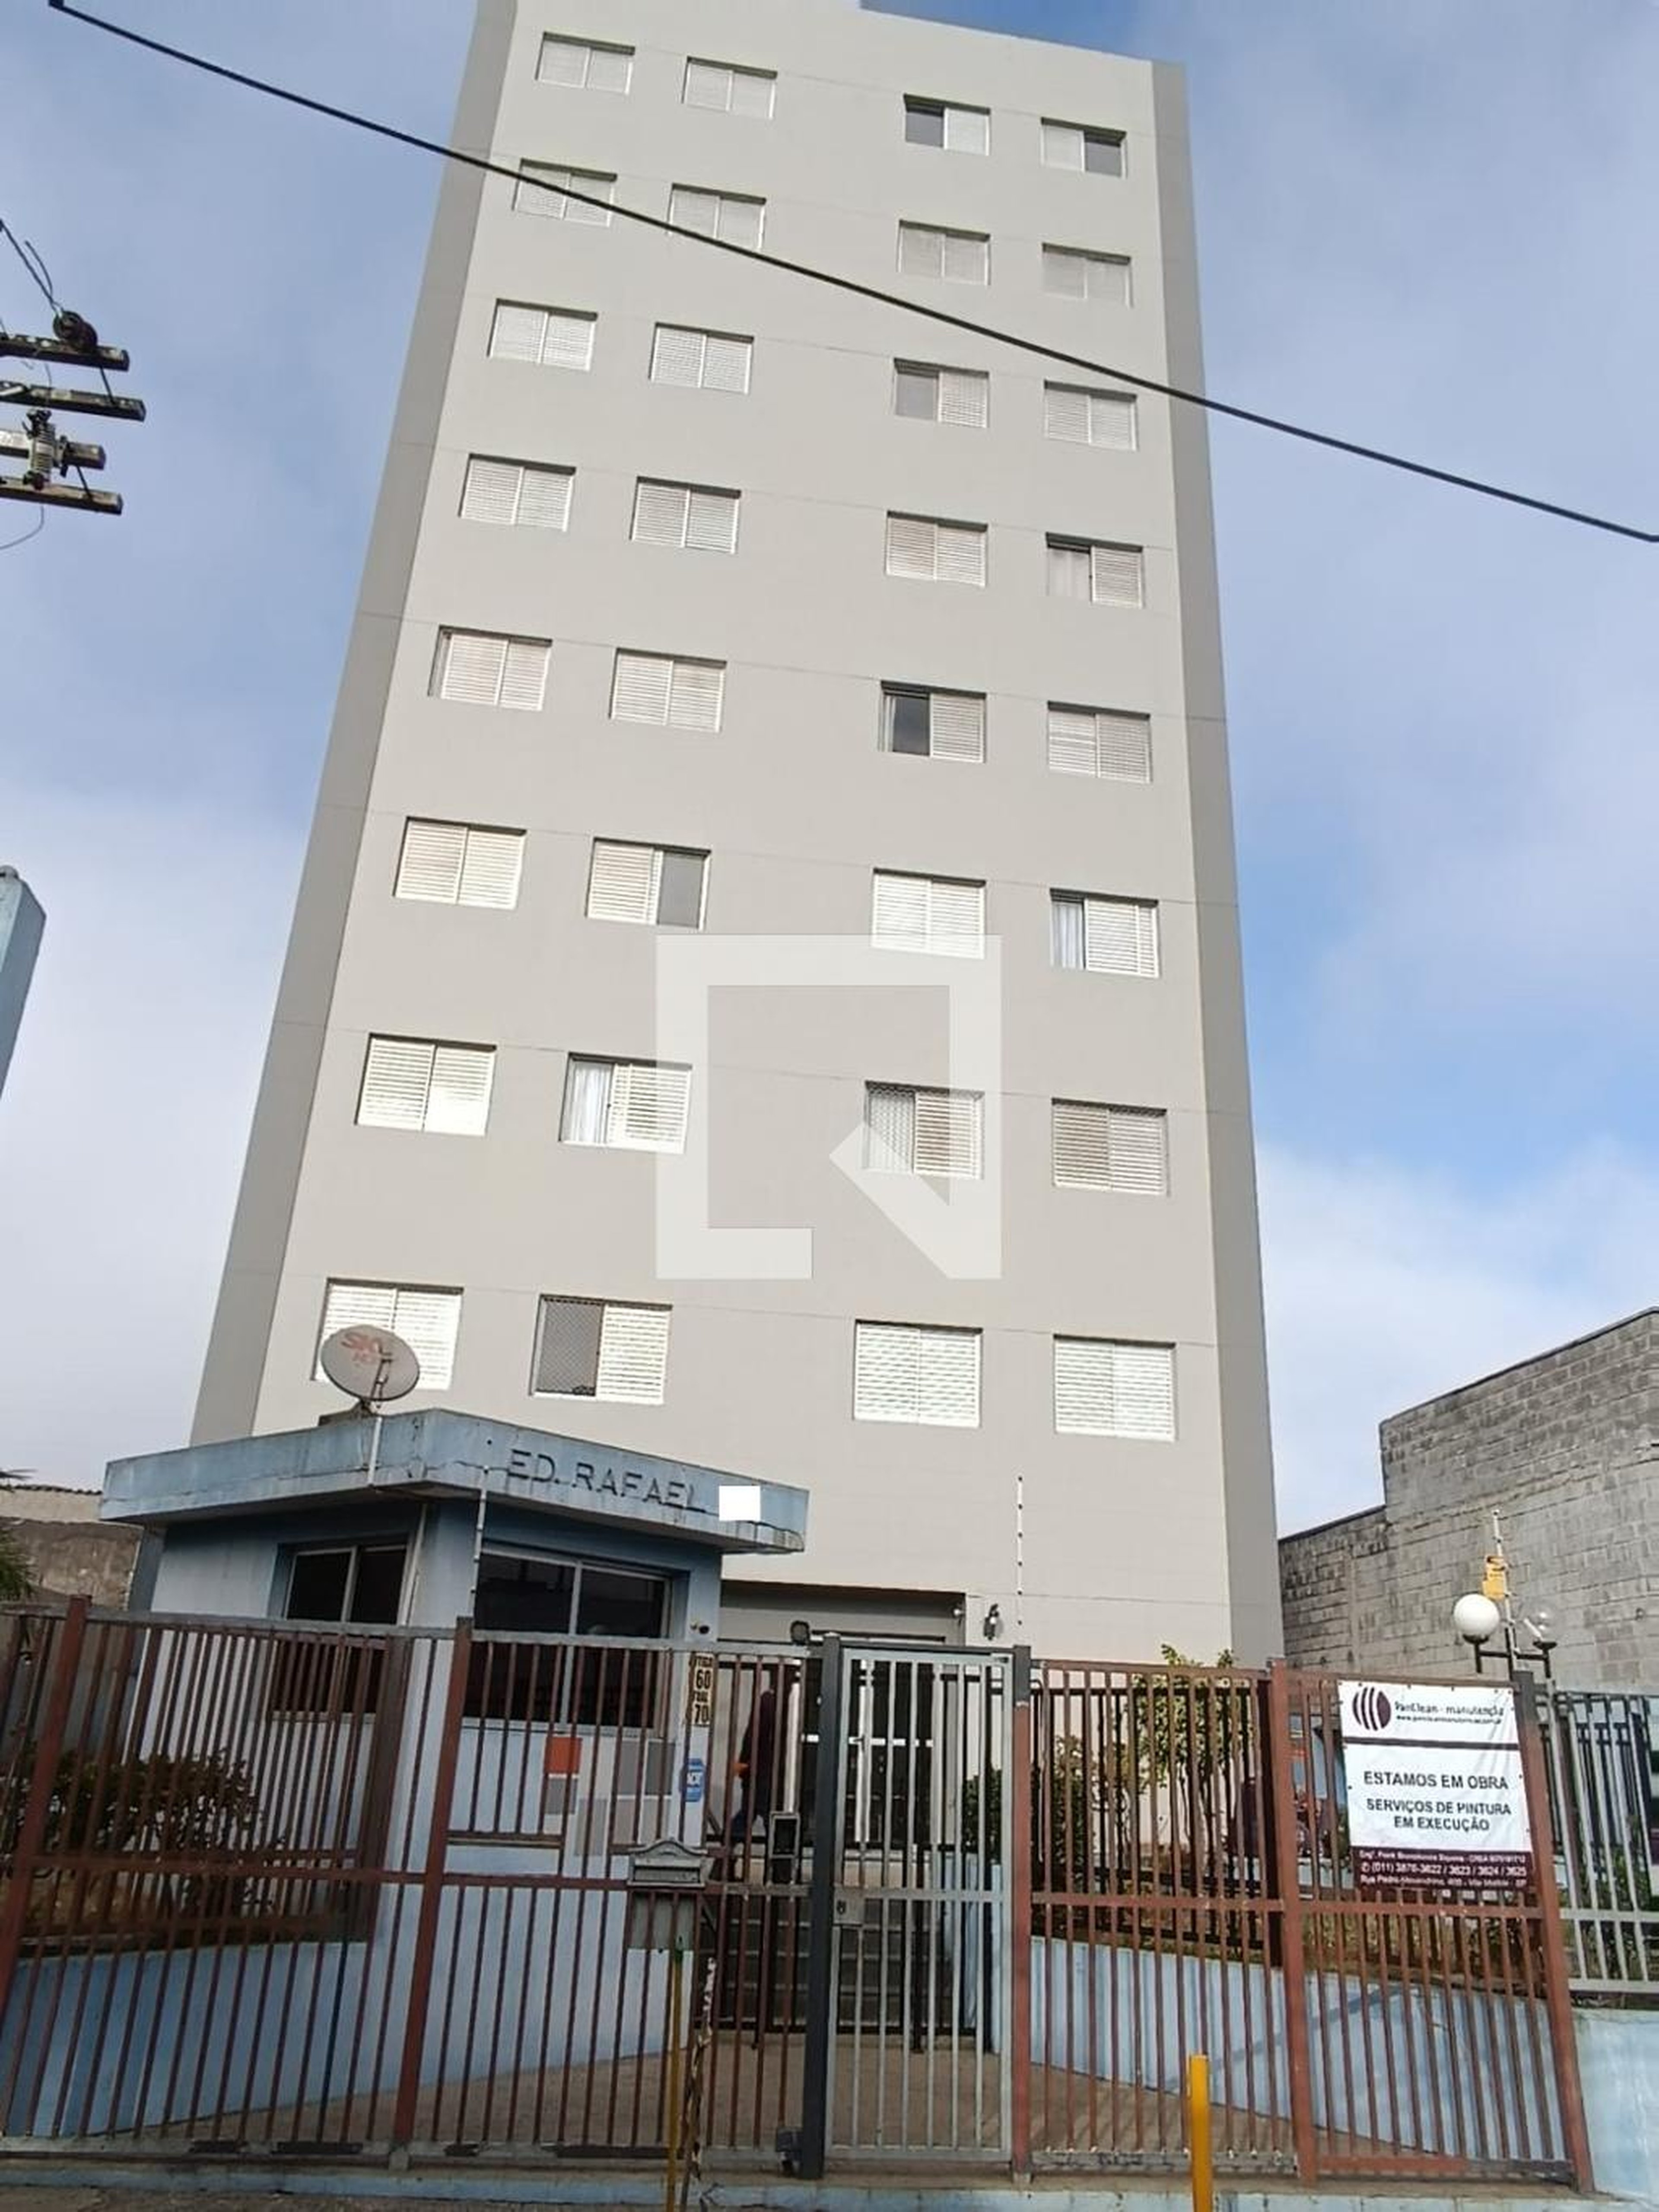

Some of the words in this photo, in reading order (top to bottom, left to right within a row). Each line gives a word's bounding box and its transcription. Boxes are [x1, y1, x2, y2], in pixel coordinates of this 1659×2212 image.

[572, 1462, 706, 1513] RAFAEL
[696, 1669, 711, 1690] 60
[695, 1704, 709, 1723] 70
[1363, 1771, 1437, 1787] ESTAMOS
[1441, 1774, 1464, 1788] EM
[1467, 1775, 1509, 1789] OBRA
[1367, 1798, 1433, 1813] SERVIÇOS
[1437, 1801, 1453, 1814] DE
[1457, 1802, 1511, 1815] PINTURA
[1394, 1816, 1414, 1828] EM
[1417, 1816, 1490, 1832] EXECUÇÃO
